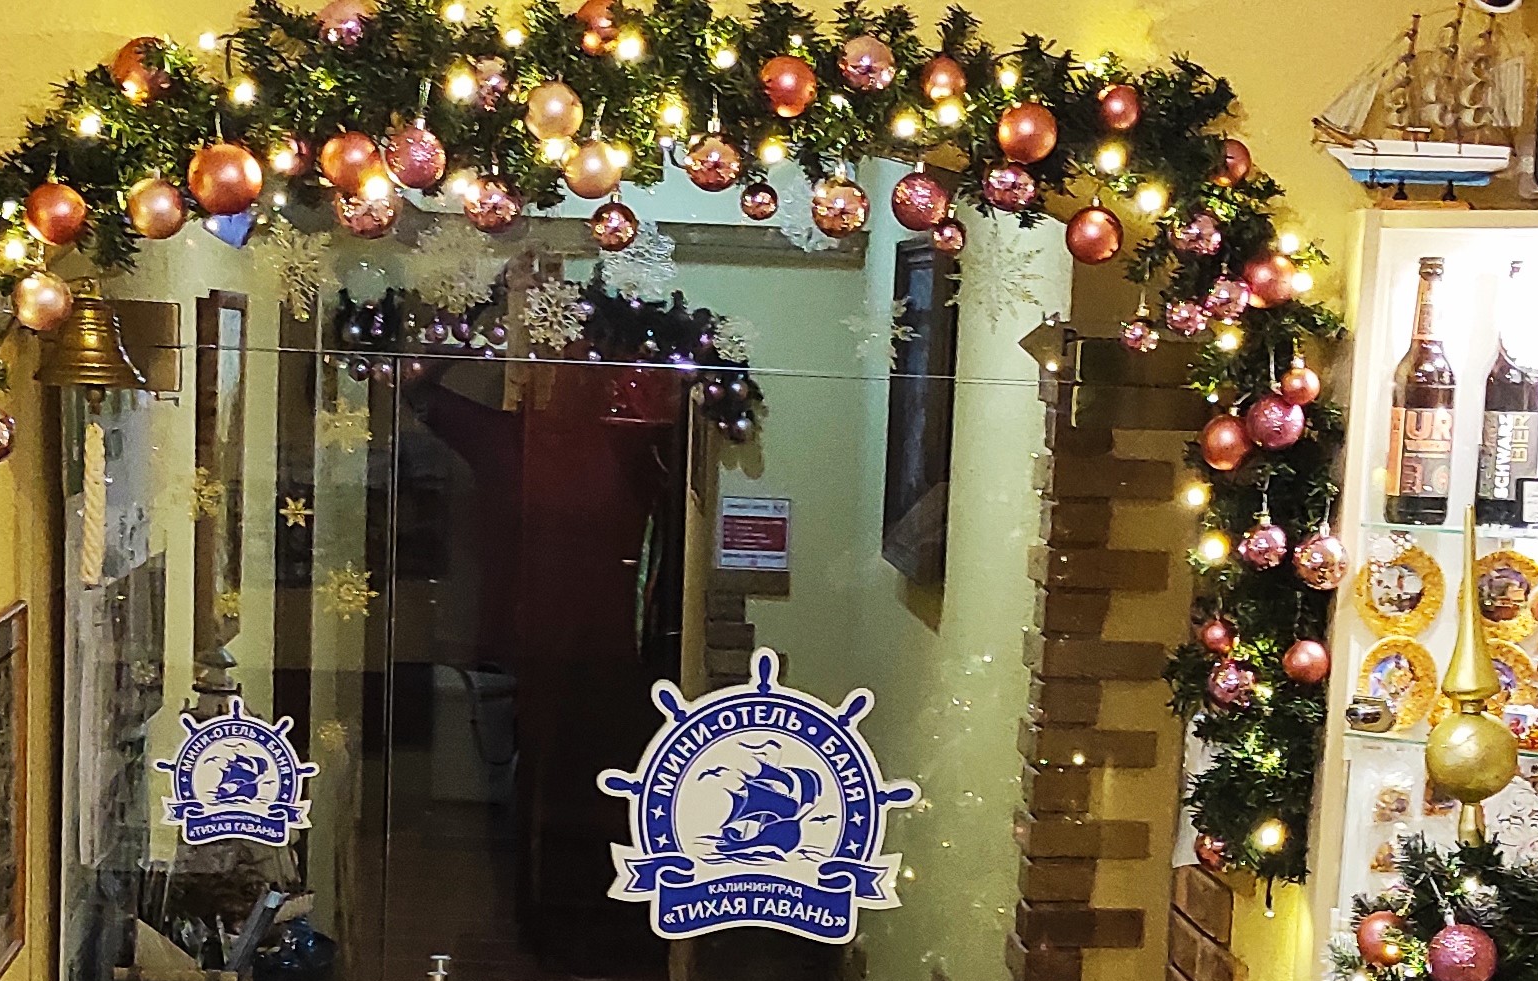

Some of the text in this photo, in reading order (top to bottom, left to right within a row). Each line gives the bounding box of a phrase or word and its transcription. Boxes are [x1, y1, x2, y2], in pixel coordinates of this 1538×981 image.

[1493, 414, 1513, 499] SCHWARZ
[1511, 415, 1530, 462] BIER
[266, 740, 292, 774] БАНЯ
[652, 705, 866, 802] МИНИ-ОТЕЛЬ БАНЯ
[707, 881, 803, 899] КАЛИНИНГРАД
[663, 897, 847, 928] «ТИХАЯ ГАВАНЬ»
